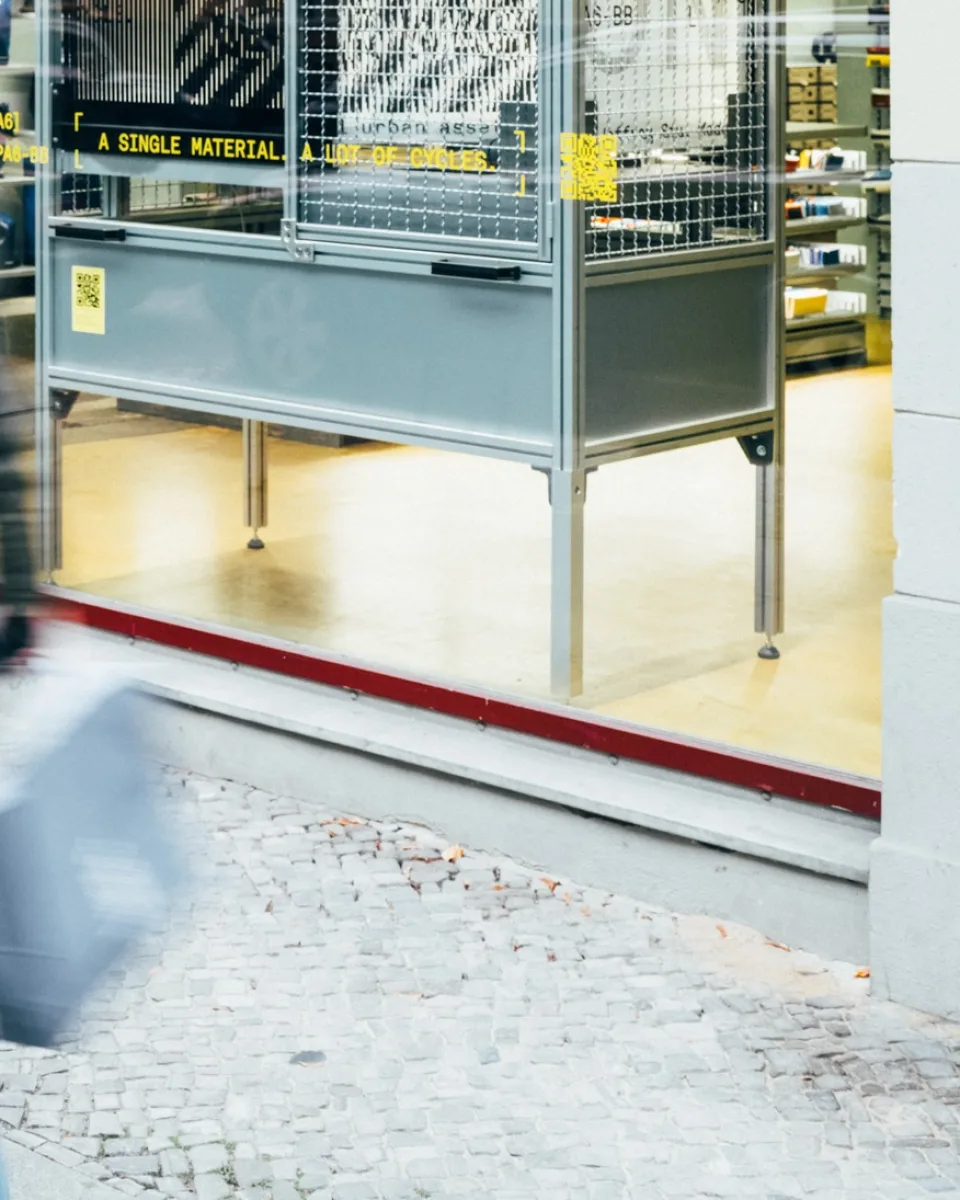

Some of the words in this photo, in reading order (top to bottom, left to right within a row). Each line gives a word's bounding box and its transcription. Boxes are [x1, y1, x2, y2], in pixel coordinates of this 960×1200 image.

[361, 119, 427, 136] urban
[98, 132, 110, 150] A
[118, 133, 181, 155] SINGLE
[301, 142, 315, 162] A
[325, 144, 361, 164] LOT
[371, 146, 398, 167] OF
